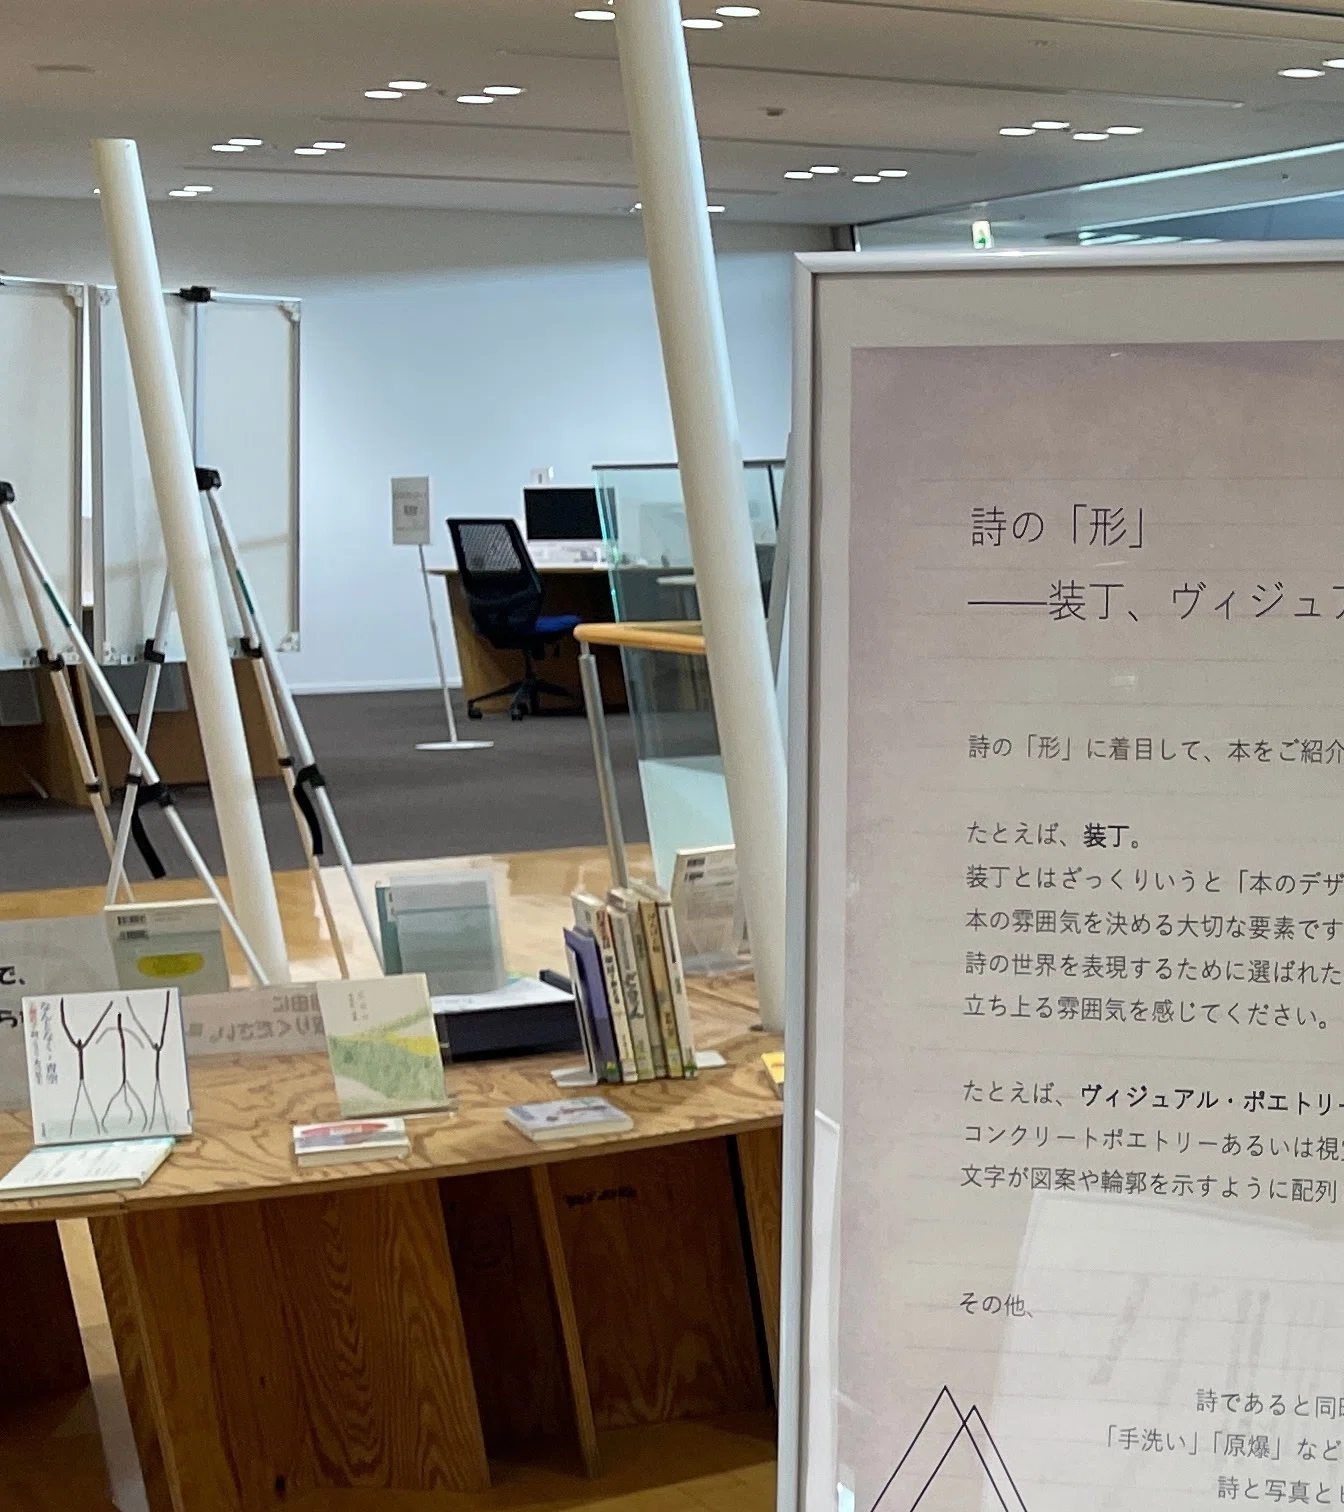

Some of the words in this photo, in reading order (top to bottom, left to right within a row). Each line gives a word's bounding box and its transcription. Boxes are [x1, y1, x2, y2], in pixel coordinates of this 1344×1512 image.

[971, 504, 1142, 548] 詩の「形」
[967, 821, 1138, 849] たとえば、装丁。
[963, 993, 1326, 1029] 立ち上る雰囲気を感じてください。
[960, 1292, 1032, 1318] その他、
